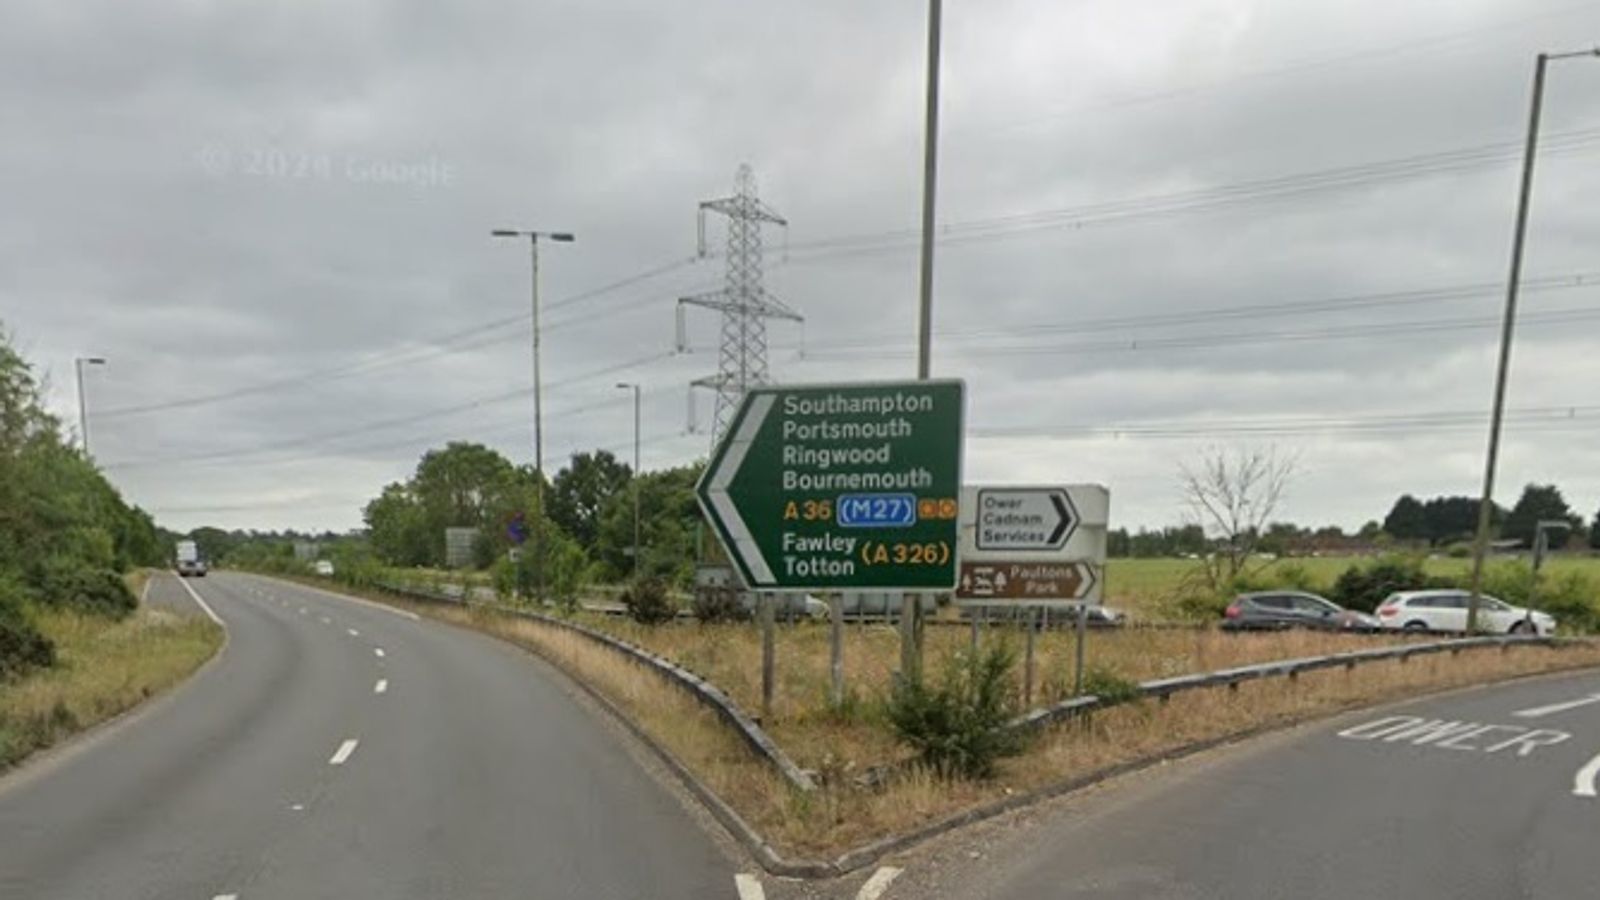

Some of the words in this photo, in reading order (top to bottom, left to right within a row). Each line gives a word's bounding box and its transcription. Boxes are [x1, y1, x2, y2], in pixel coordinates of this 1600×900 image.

[784, 393, 933, 415] Southampton
[783, 418, 912, 440] Portsmouth
[783, 443, 890, 468] Ringwood
[783, 468, 933, 490] Bournemouth
[841, 499, 912, 521] (M27)
[983, 512, 1043, 525] Cadnam
[783, 533, 857, 555] Fawley
[983, 529, 1045, 542] Services
[783, 557, 854, 577] Totton
[1010, 565, 1073, 579] Paultons
[1025, 581, 1058, 593] Park
[1337, 715, 1571, 756] OWER
